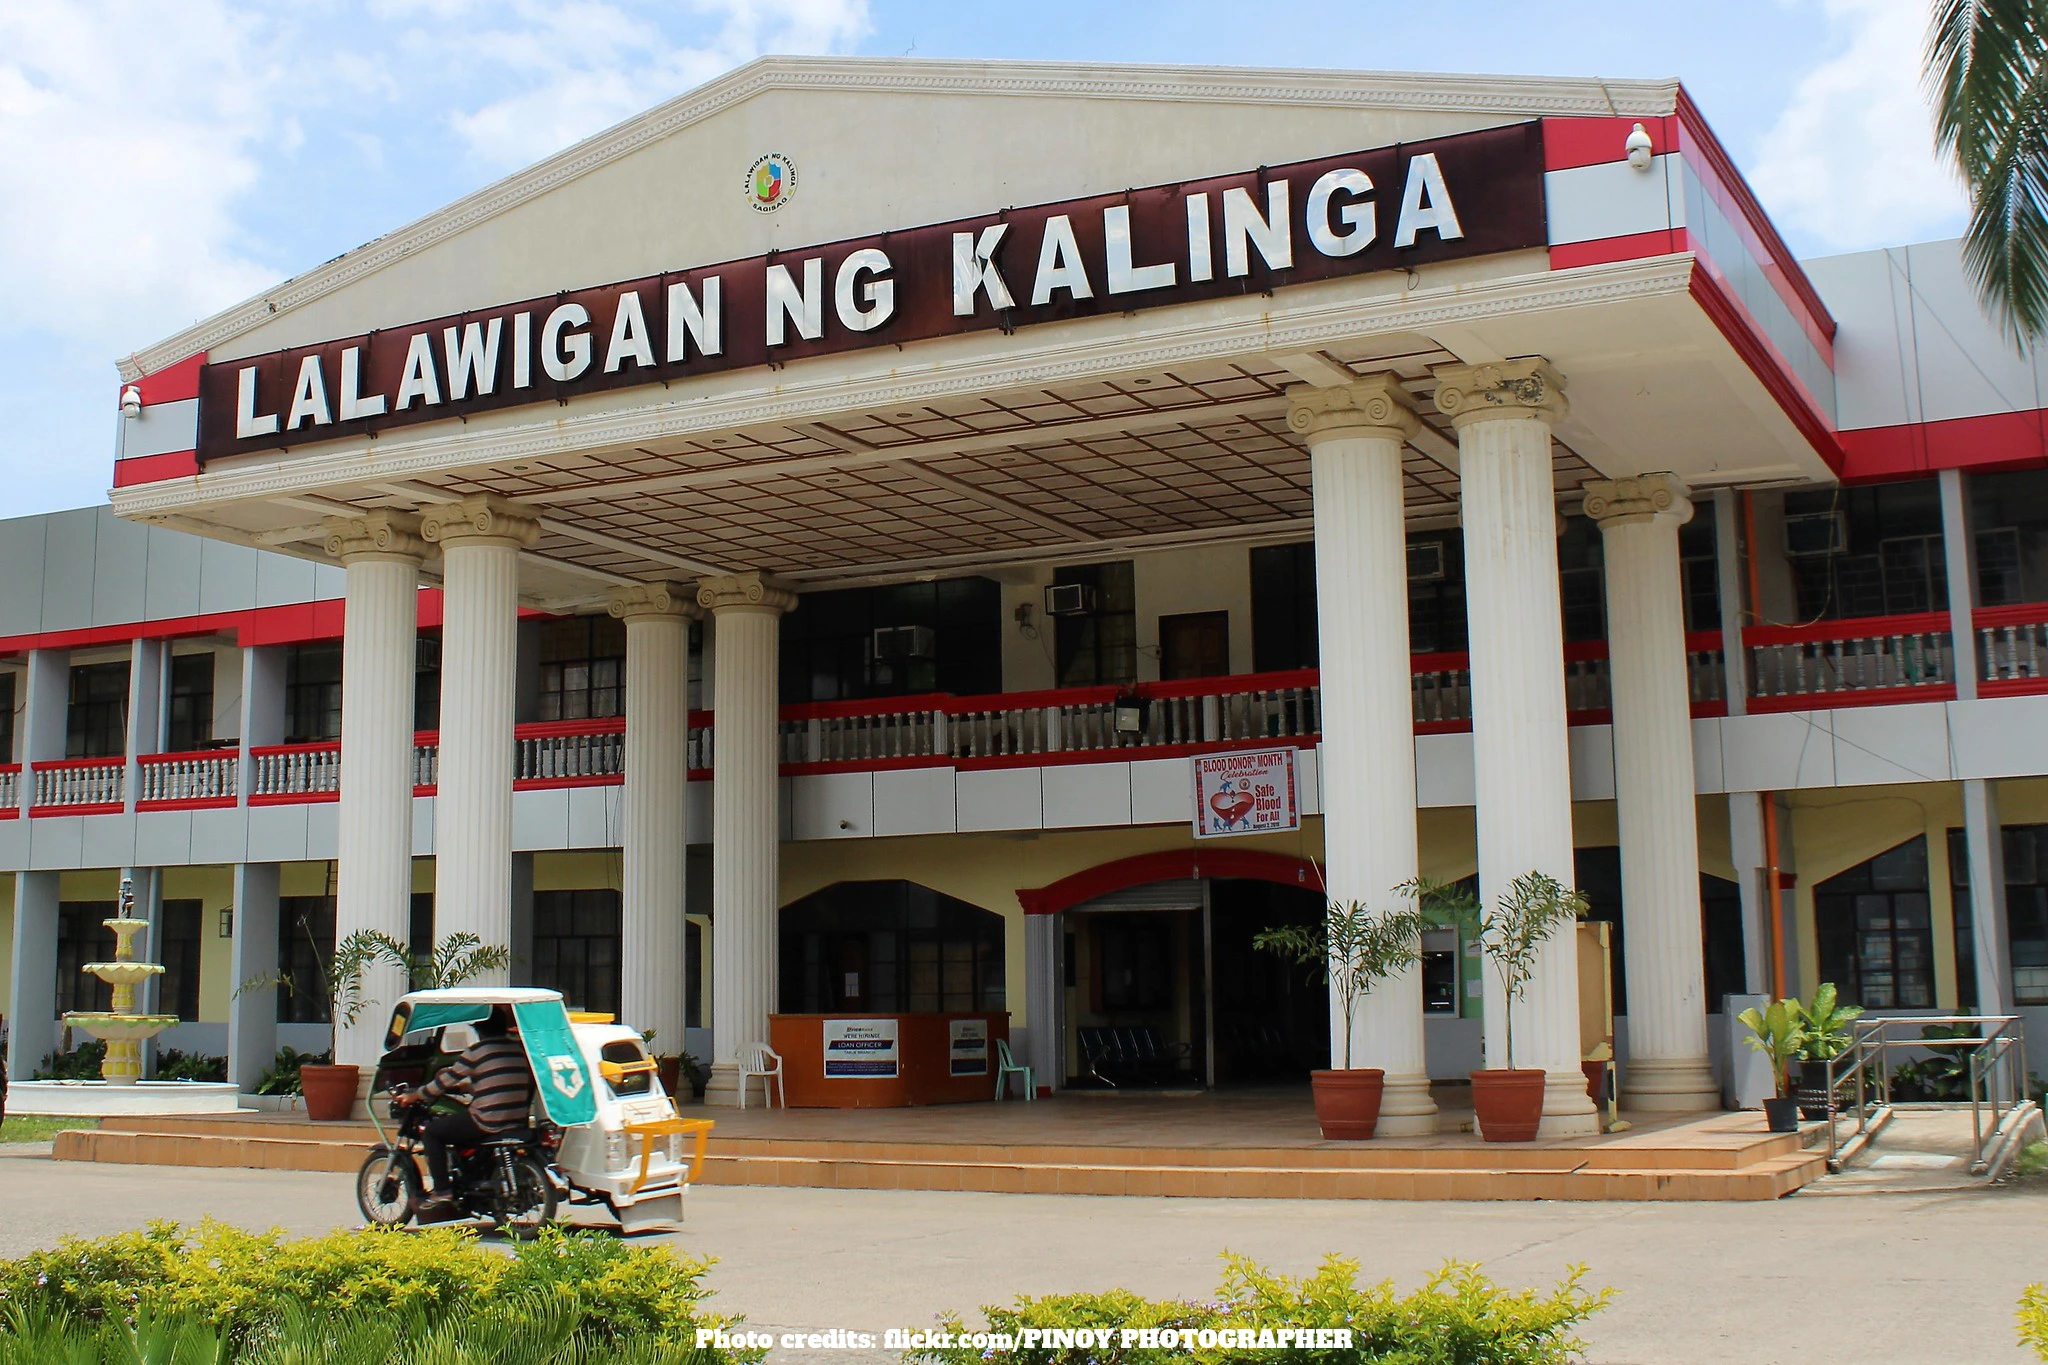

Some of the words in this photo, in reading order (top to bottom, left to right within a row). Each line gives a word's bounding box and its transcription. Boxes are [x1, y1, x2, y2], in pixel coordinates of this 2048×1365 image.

[236, 274, 723, 440] LALAWIGAN
[765, 248, 895, 347] NG
[952, 152, 1465, 317] KALINGA
[1203, 760, 1227, 773] BLOOD
[1257, 753, 1283, 767] MONTH
[1220, 768, 1269, 780] Celebration
[1255, 784, 1275, 797] Safe
[1256, 796, 1282, 811] Blood
[1256, 812, 1268, 822] For
[1269, 811, 1280, 821] All
